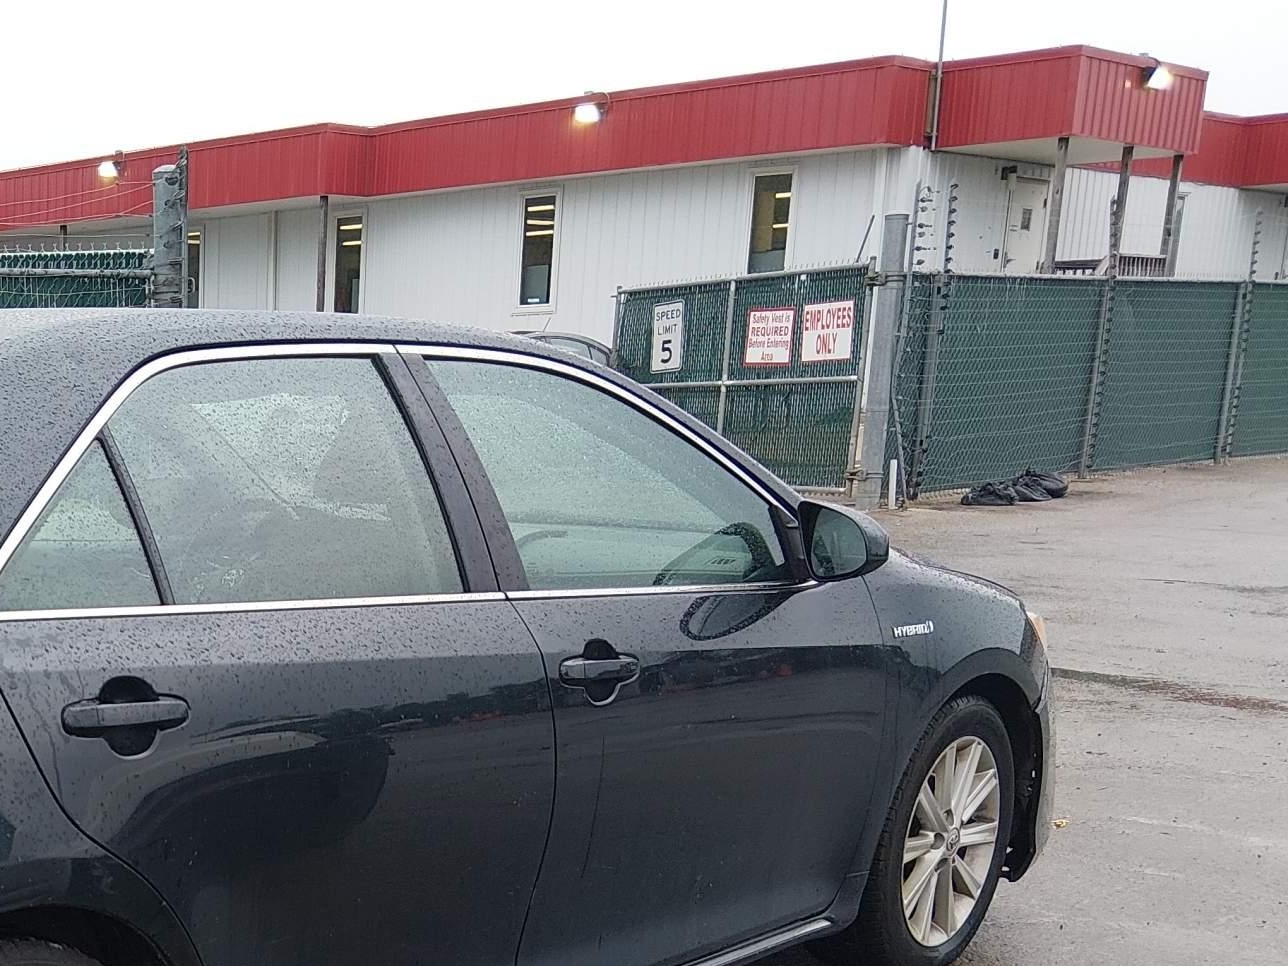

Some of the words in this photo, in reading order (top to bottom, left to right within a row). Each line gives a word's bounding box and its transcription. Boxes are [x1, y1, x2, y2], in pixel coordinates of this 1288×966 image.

[656, 309, 681, 321] SPEED
[752, 313, 769, 326] Safety
[771, 313, 784, 324] Vest
[804, 306, 852, 332] EMPLOYEES
[657, 324, 677, 336] LIMIT
[751, 326, 789, 338] REQUIRED
[748, 338, 766, 349] Before
[767, 337, 789, 350] Entering
[816, 332, 838, 355] ONLY
[660, 339, 672, 364] 5
[760, 352, 773, 361] Area
[893, 622, 931, 638] HYBRID
